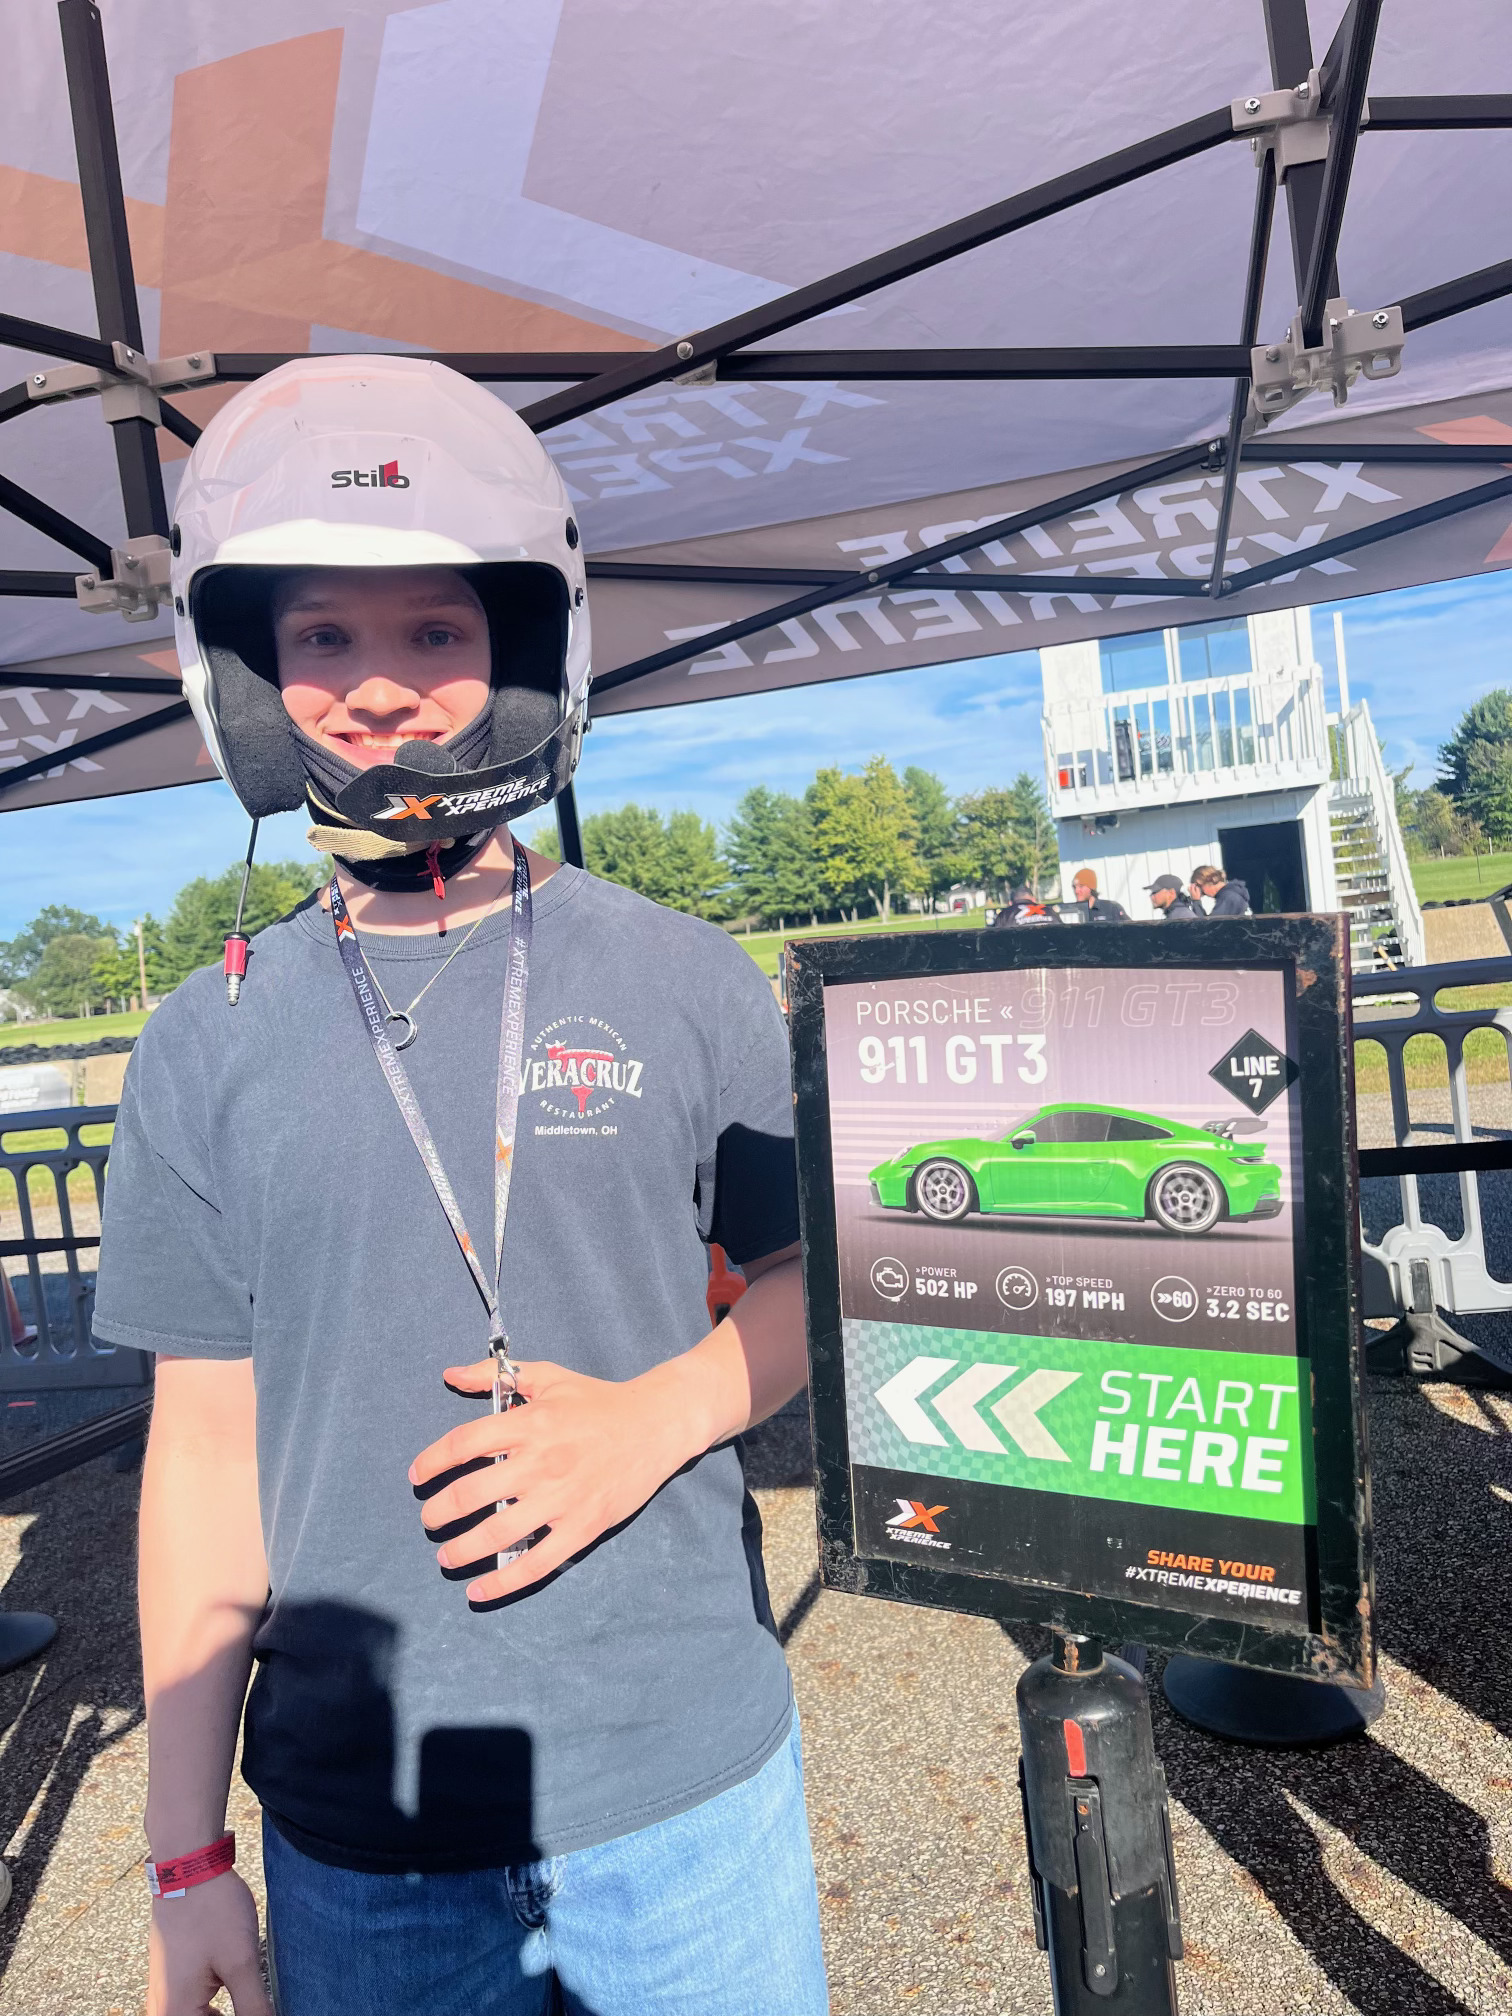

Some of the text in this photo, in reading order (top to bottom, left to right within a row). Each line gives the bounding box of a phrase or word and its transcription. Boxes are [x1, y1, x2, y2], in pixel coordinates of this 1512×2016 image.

[331, 460, 410, 489] Stilo
[437, 776, 528, 808] XTREME
[445, 775, 550, 817] XPERIENCE
[502, 936, 527, 1097] #XTREMEXPERIENCE
[856, 998, 991, 1026] PORSCHE
[1019, 982, 1239, 1029] 911 GT3
[530, 1015, 628, 1051] AUTHENTIC MEXICAN
[857, 1034, 1047, 1084] 911 GT3
[1230, 1054, 1280, 1077] LINE
[1248, 1078, 1263, 1098] 7
[539, 1097, 616, 1119] RESTAURANT
[534, 1125, 618, 1136] Middletown, OH
[915, 1278, 978, 1300] 502 HP
[1076, 1277, 1113, 1289] SPEED
[1248, 1288, 1264, 1299] TO
[1267, 1288, 1283, 1300] 60
[1045, 1287, 1126, 1312] 197 MPH
[1206, 1298, 1290, 1323] 3.2 SEC
[1098, 1369, 1297, 1430] START
[1089, 1420, 1290, 1493] HERE
[885, 1527, 934, 1541] XTREME
[889, 1534, 952, 1549] XPERIENCE
[1147, 1549, 1276, 1583] SHARE YOUR
[1125, 1565, 1303, 1605] #XTREMEXPERIENCE
